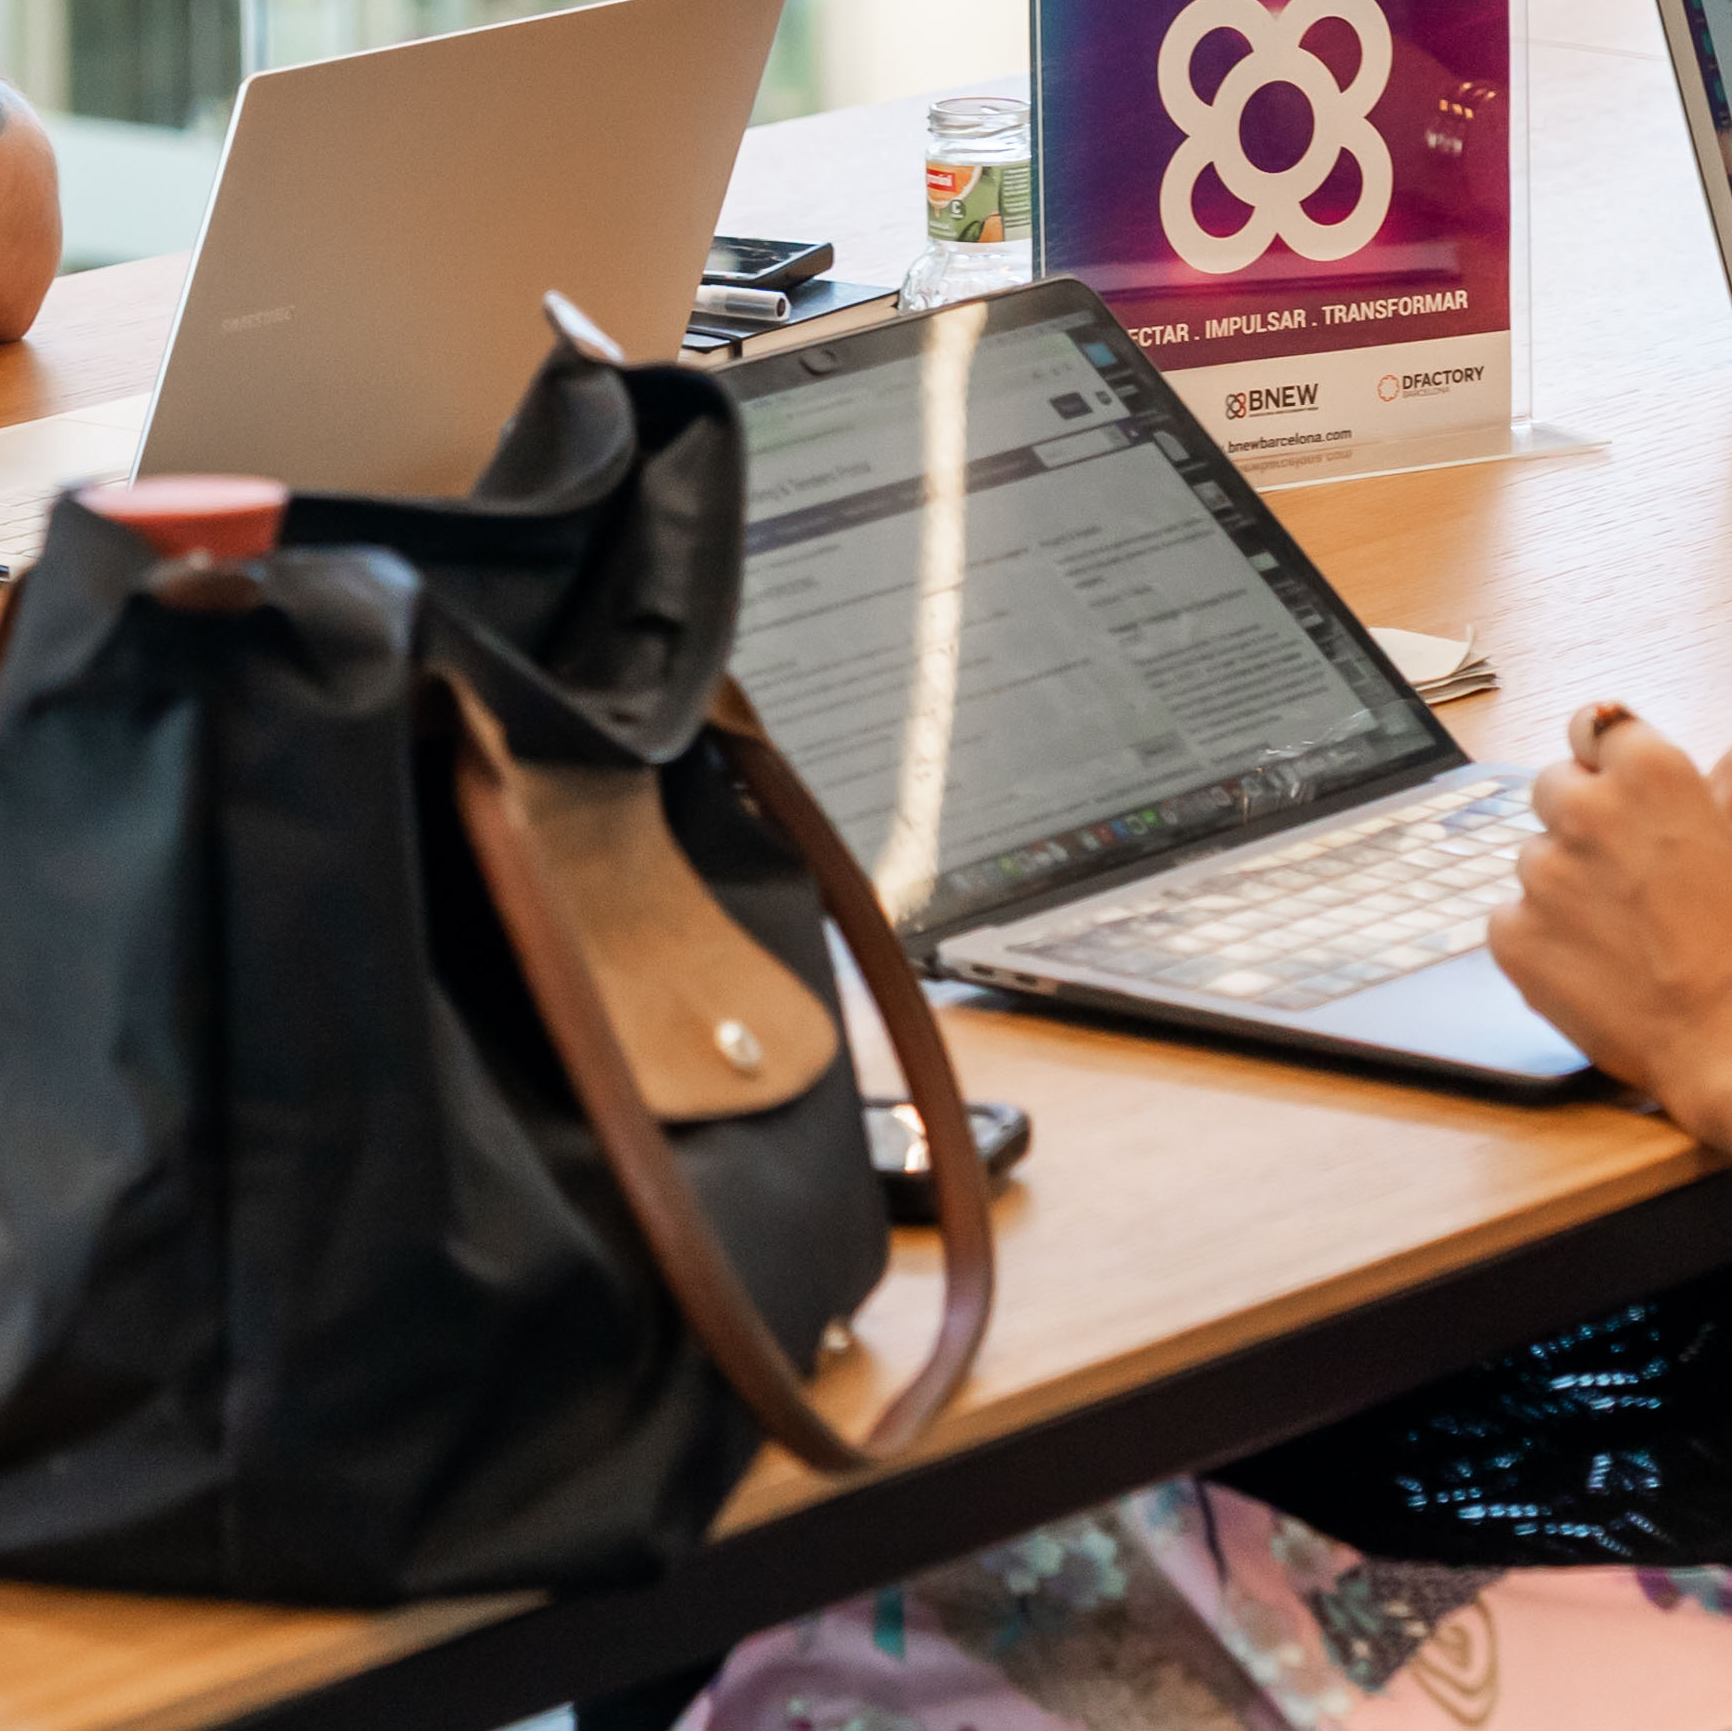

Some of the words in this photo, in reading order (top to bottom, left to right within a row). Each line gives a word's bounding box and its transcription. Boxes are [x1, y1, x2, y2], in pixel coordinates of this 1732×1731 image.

[1205, 308, 1307, 340] IMPULSAR
[1321, 289, 1469, 327] TRANSFORMAR
[1401, 365, 1485, 390] DFACTORY
[1249, 383, 1320, 411] BNEW
[1228, 427, 1353, 454] bnewbarcelona.com
